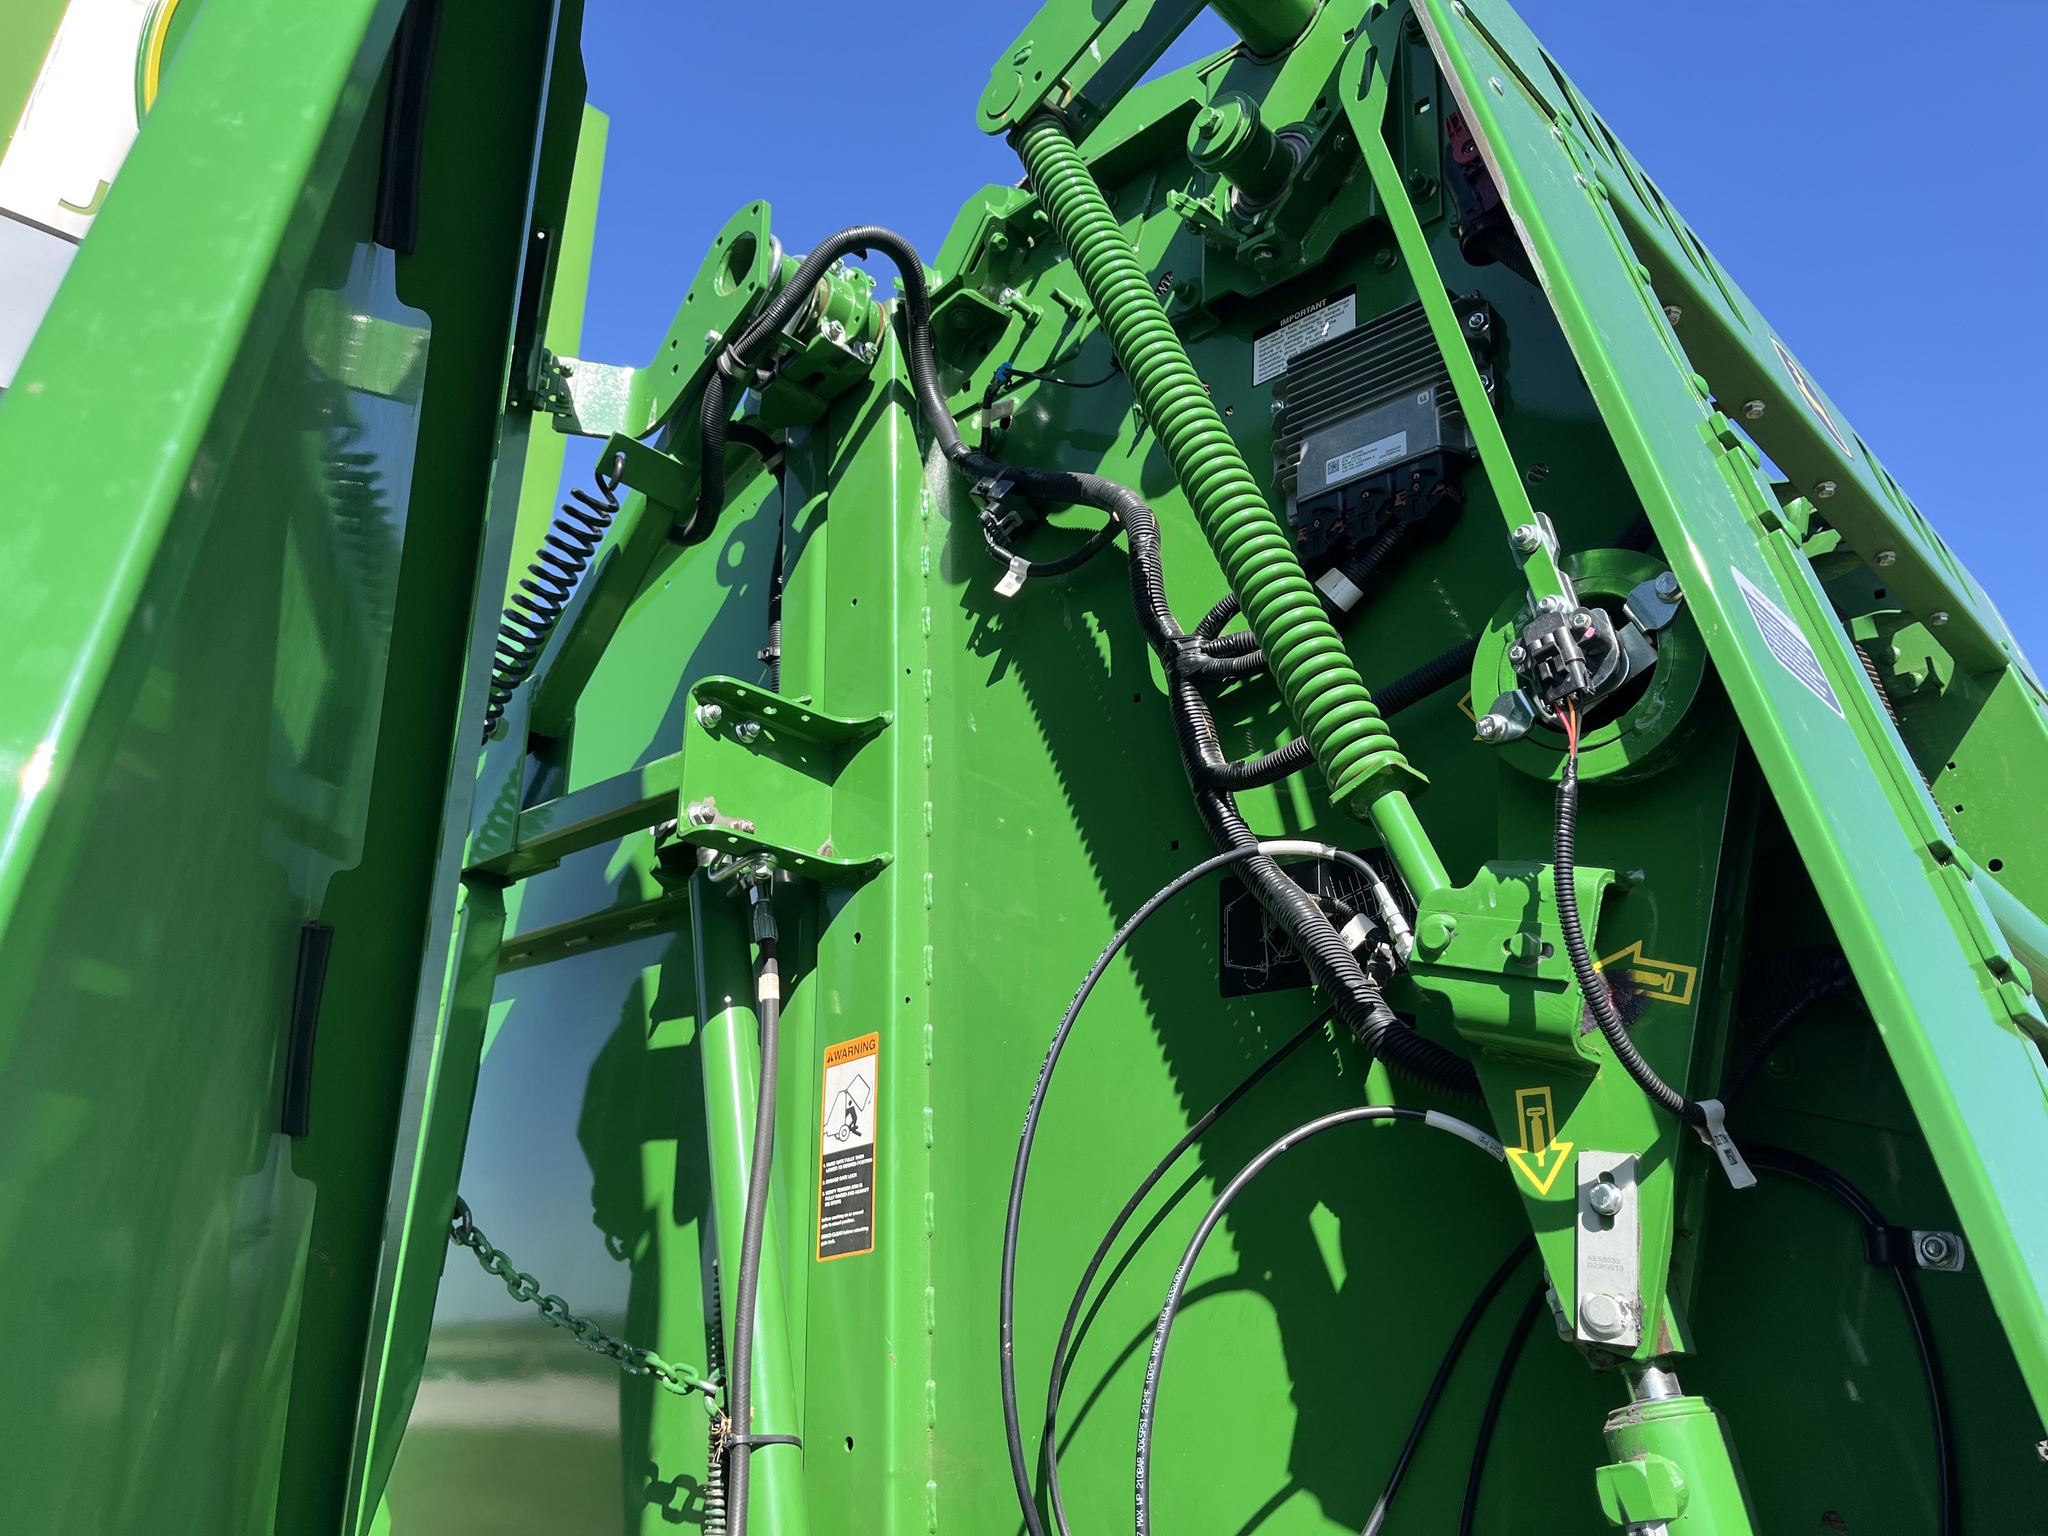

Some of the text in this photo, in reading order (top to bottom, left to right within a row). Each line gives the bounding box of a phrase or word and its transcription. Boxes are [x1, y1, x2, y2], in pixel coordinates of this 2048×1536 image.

[1280, 298, 1327, 327] IMPORTANT
[834, 1039, 876, 1061] WARNING
[1158, 1305, 1171, 1321] USA
[1155, 1323, 1165, 1334] IN
[1149, 1336, 1162, 1358] MADE
[1137, 1418, 1148, 1453] 3045PSI
[1135, 1456, 1145, 1489] 210BAR
[1136, 1494, 1144, 1505] WP
[1135, 1509, 1144, 1526] MAX
